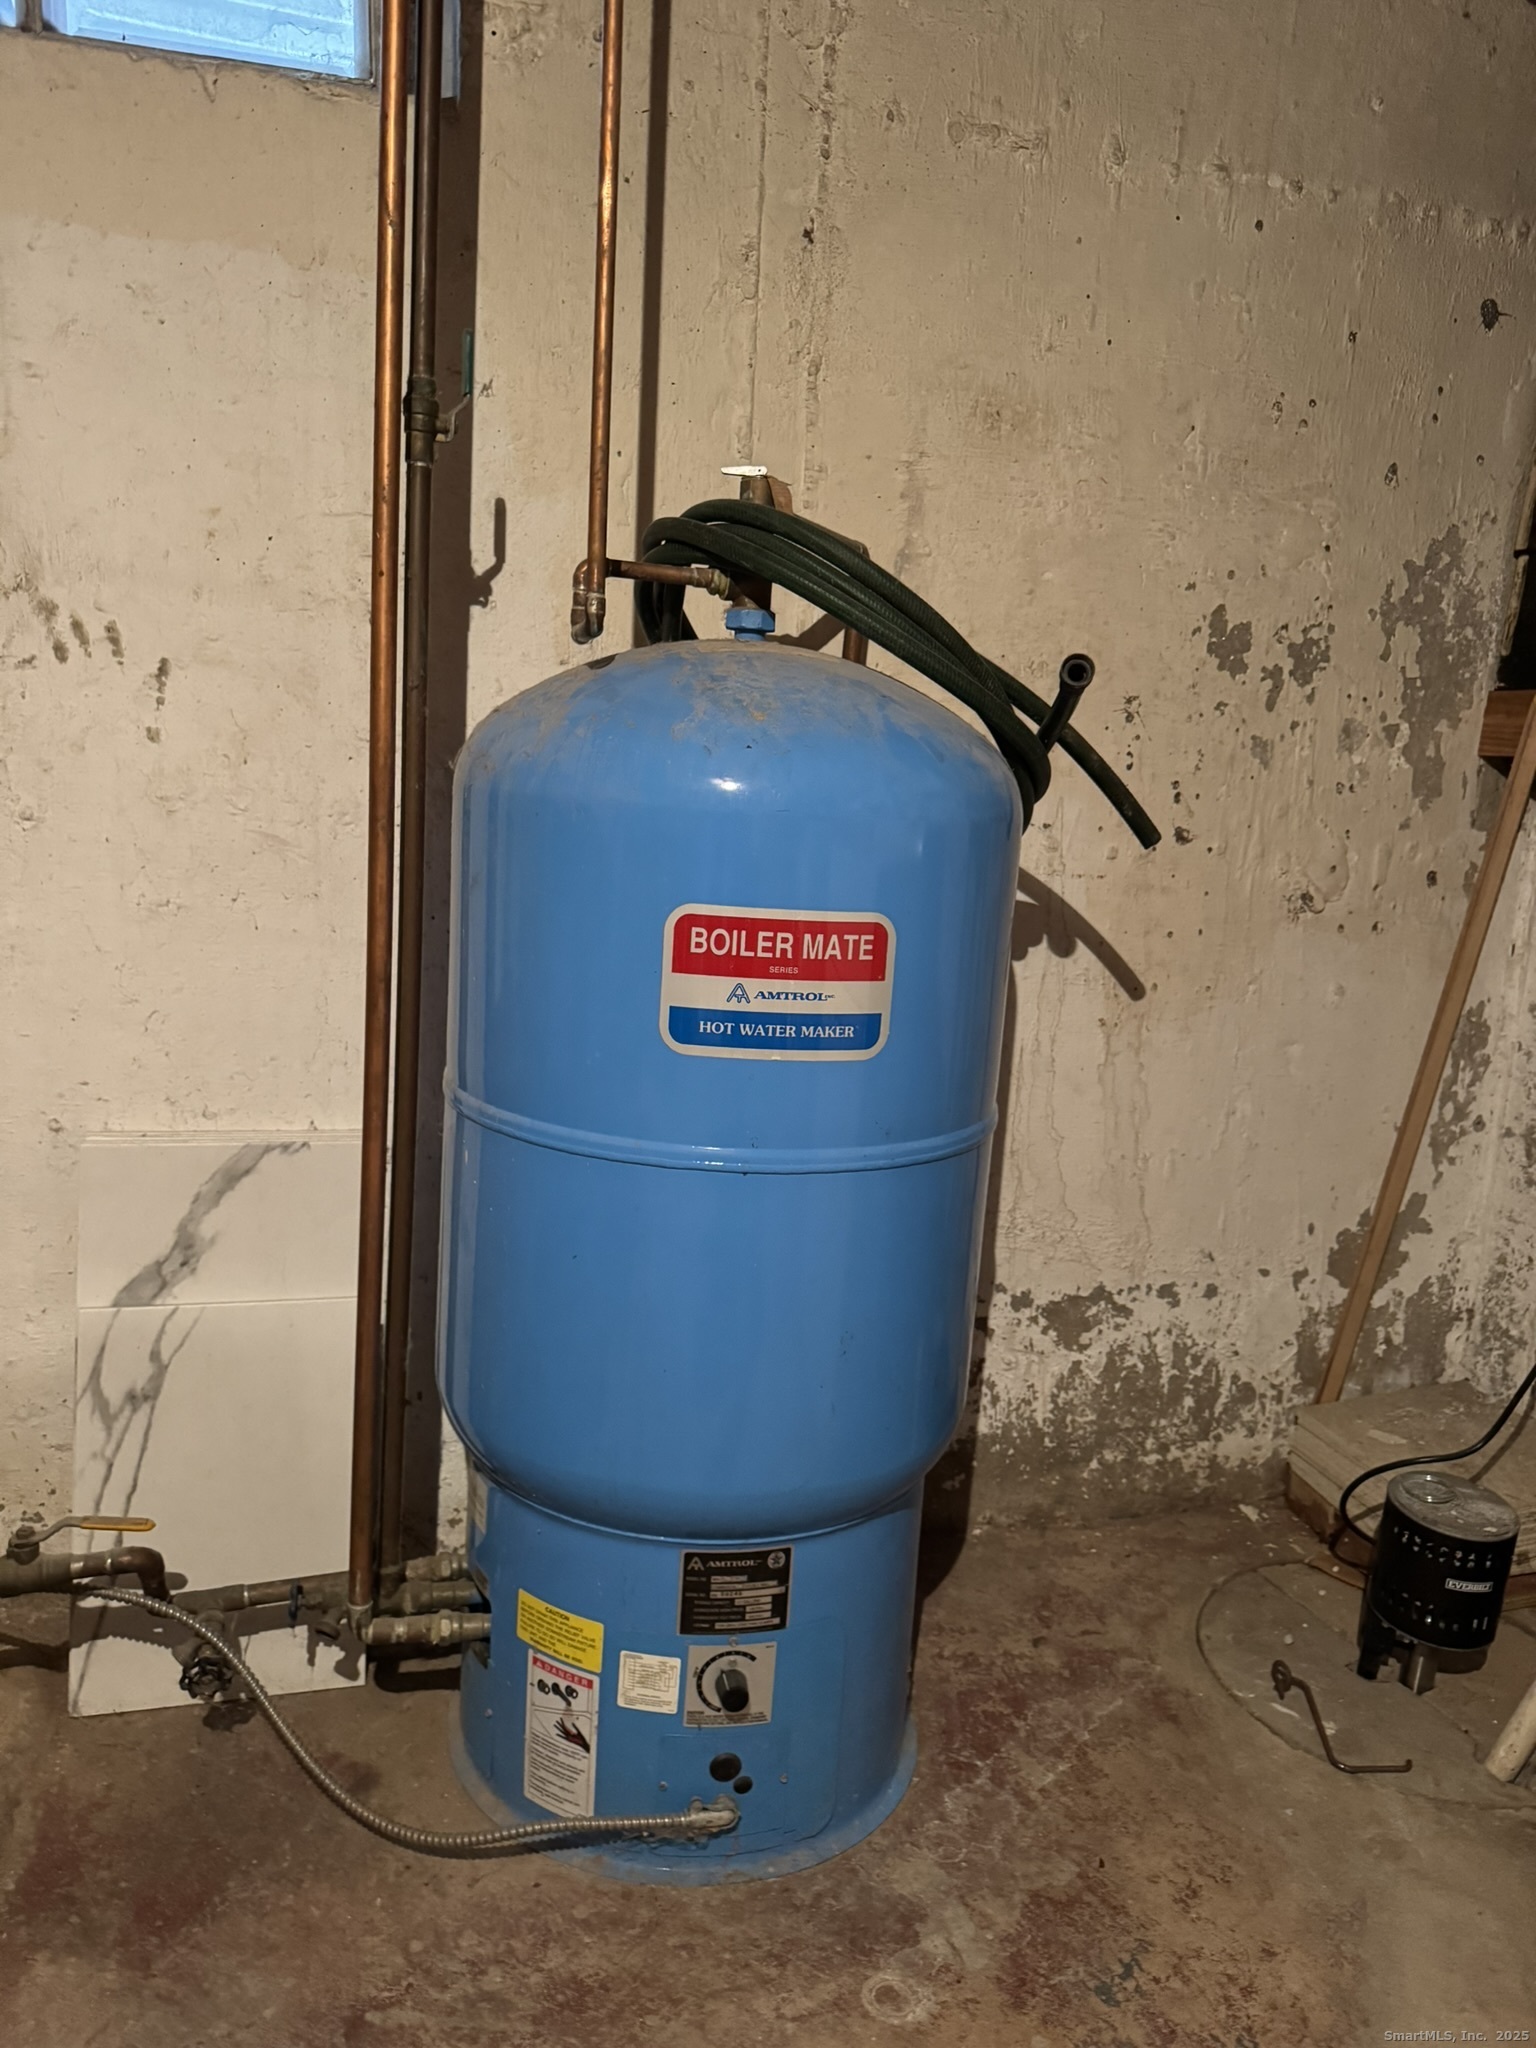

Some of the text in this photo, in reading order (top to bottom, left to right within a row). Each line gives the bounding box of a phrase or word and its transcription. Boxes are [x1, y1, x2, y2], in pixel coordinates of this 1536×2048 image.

[690, 926, 875, 961] BOILER MATE
[769, 965, 799, 975] SERIES
[754, 991, 828, 1001] AMTROL
[699, 1020, 855, 1038] HOT WATER MAKER
[544, 1663, 588, 1686] DANGER
